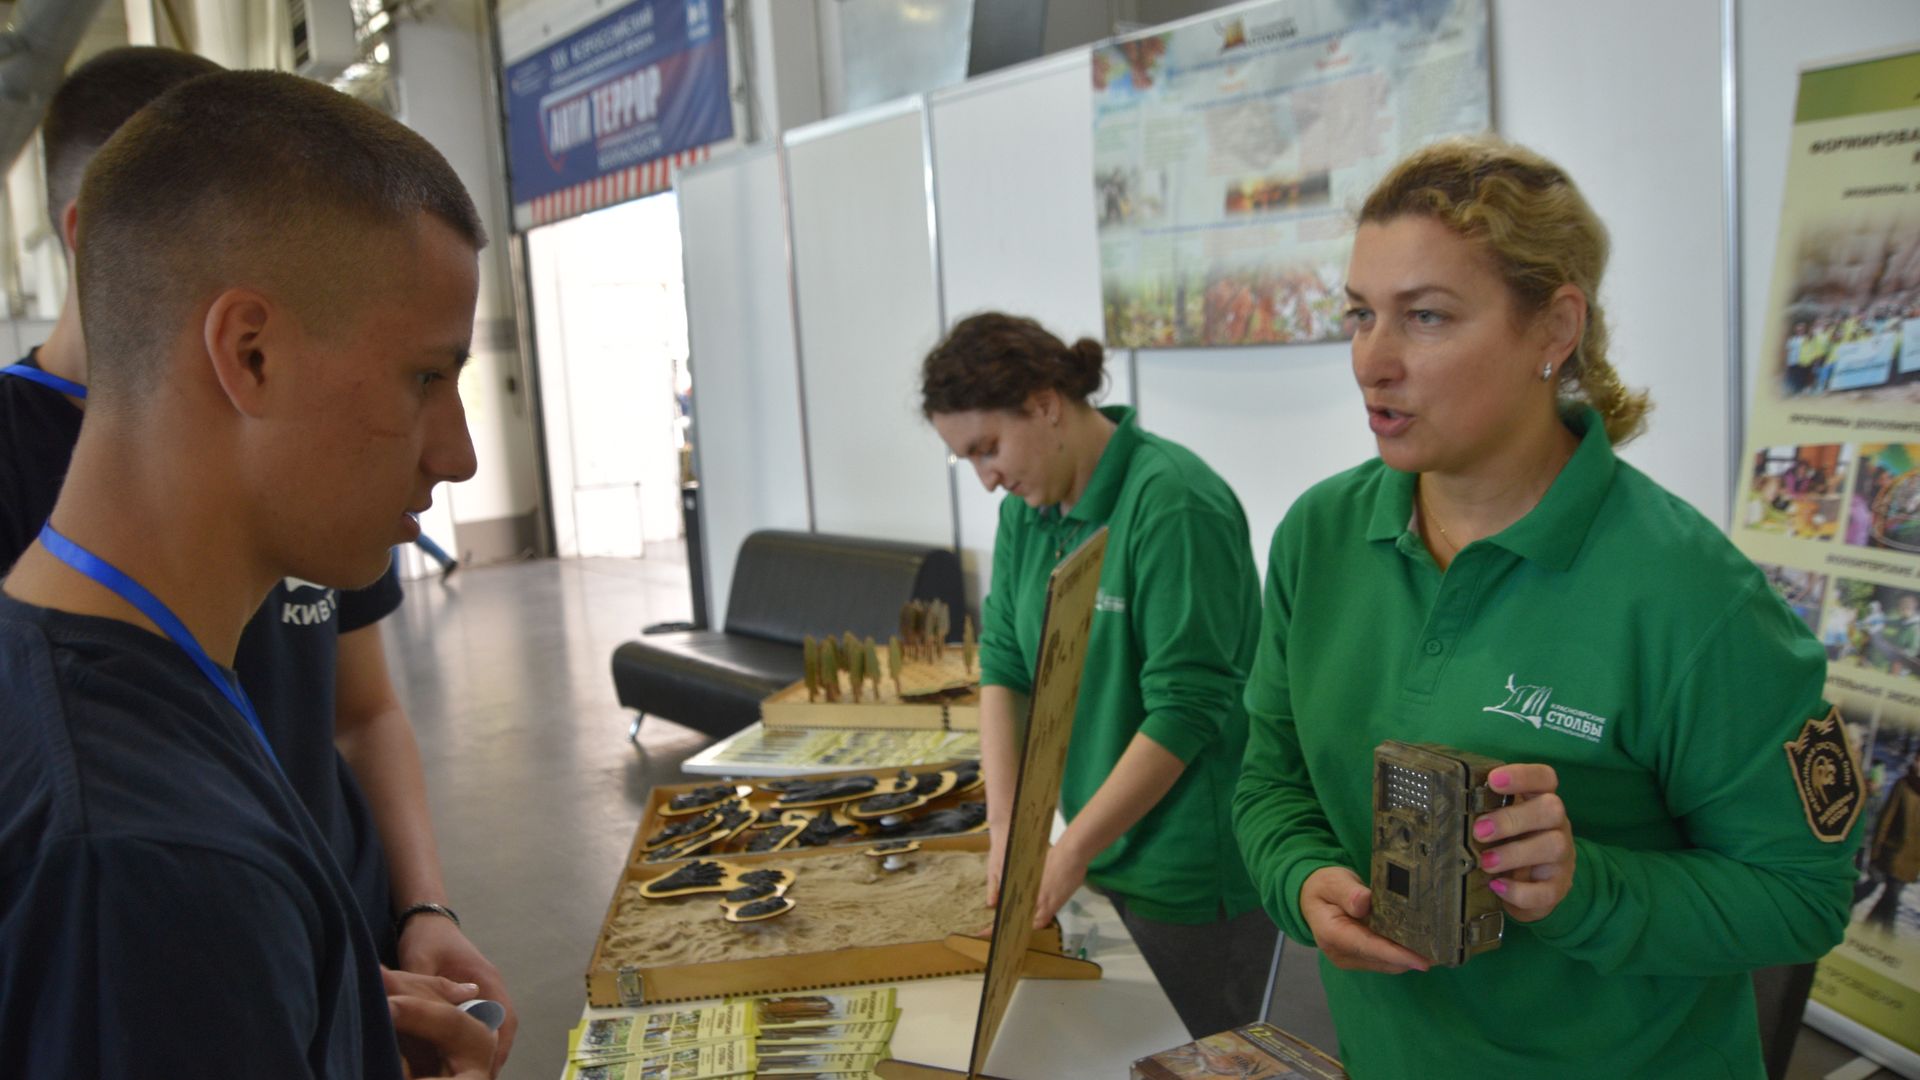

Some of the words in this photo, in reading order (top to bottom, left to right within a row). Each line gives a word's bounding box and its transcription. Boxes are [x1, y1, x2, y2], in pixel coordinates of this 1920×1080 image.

[592, 64, 662, 140] ТЕРРОР
[1545, 710, 1603, 738] СТОЛБЫ
[1551, 703, 1606, 724] КРАСНОЯРСКИЕ
